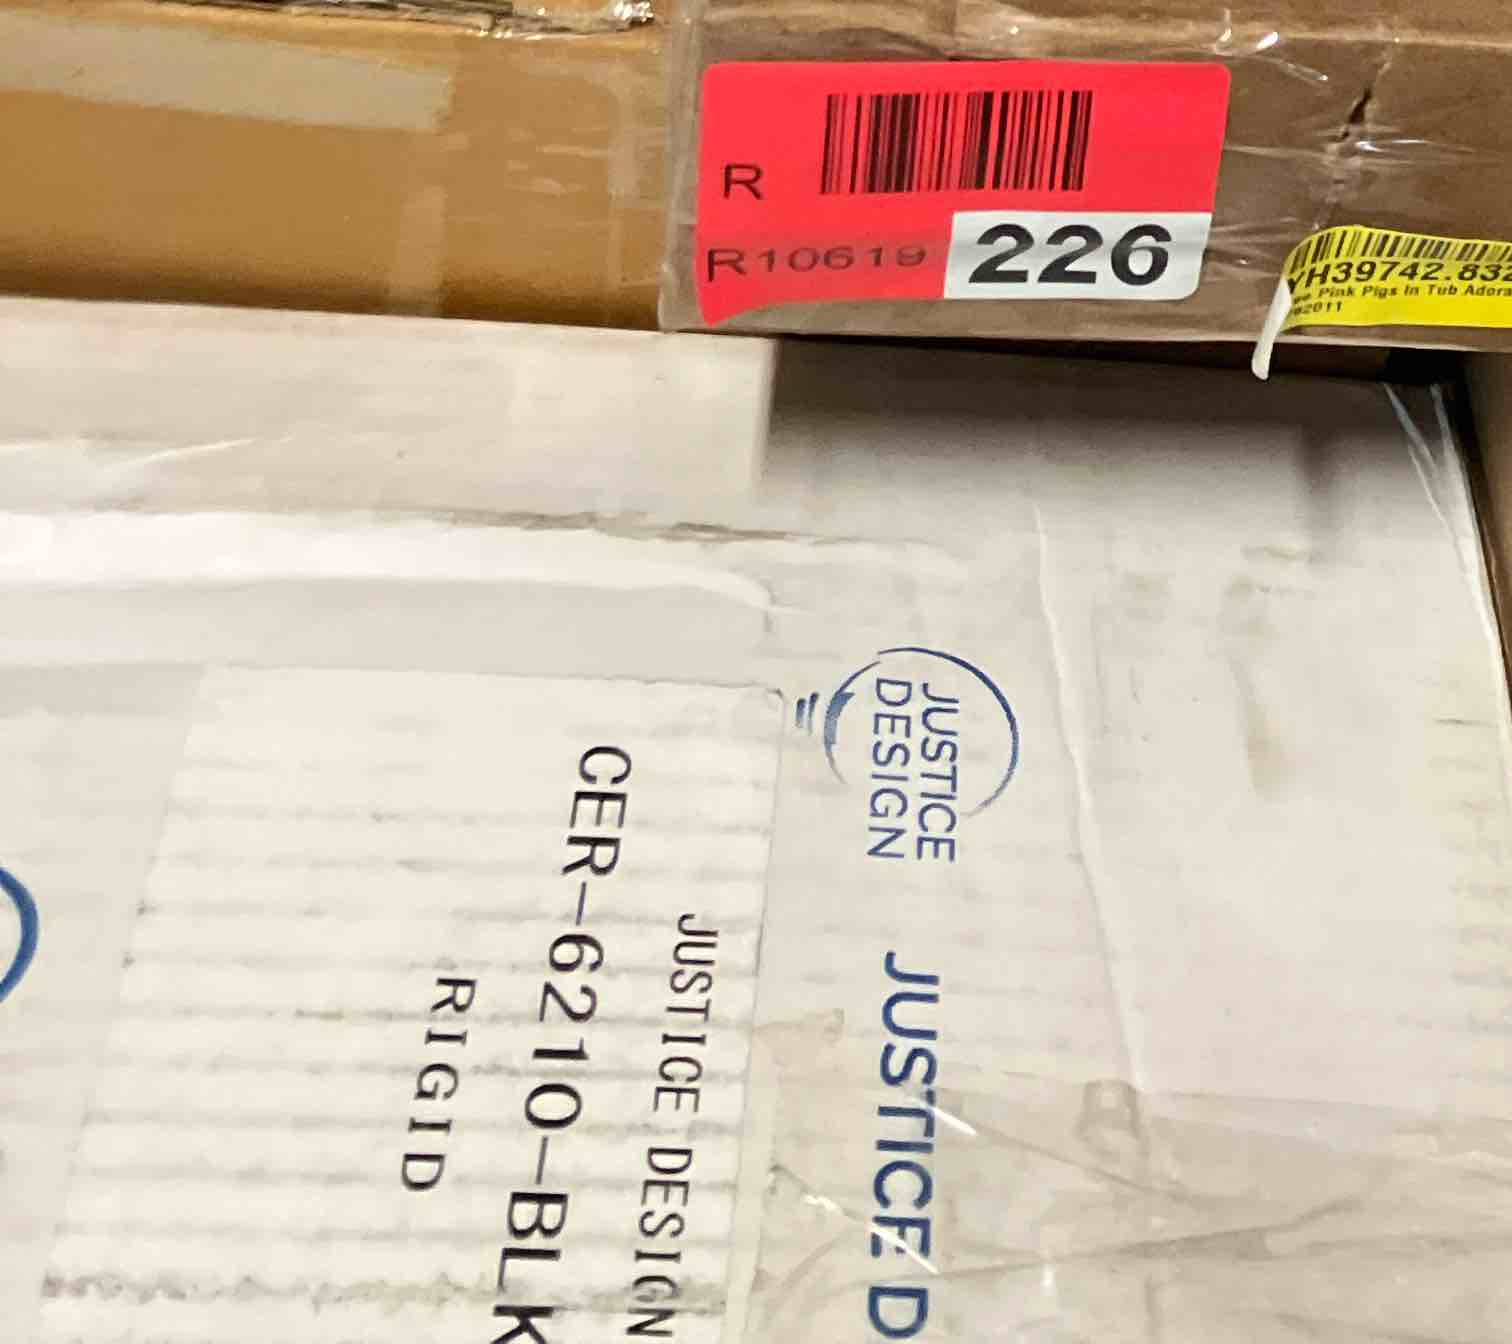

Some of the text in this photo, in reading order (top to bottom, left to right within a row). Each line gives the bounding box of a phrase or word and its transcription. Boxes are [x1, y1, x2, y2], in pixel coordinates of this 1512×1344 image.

[706, 245, 927, 282] R10619
[722, 163, 765, 200] R
[968, 223, 1173, 286] 226
[1318, 285, 1355, 298] Pink
[1362, 284, 1398, 299] Pigs
[1427, 285, 1458, 297] Tub
[867, 678, 914, 859] DESIGN
[916, 682, 960, 863] JUSTICE
[400, 976, 478, 1192] RIGID
[490, 745, 633, 1344] CER-6210-BLK
[626, 913, 719, 1337] JUSTICE DESIGN
[867, 951, 941, 1341] JUSTICE D
